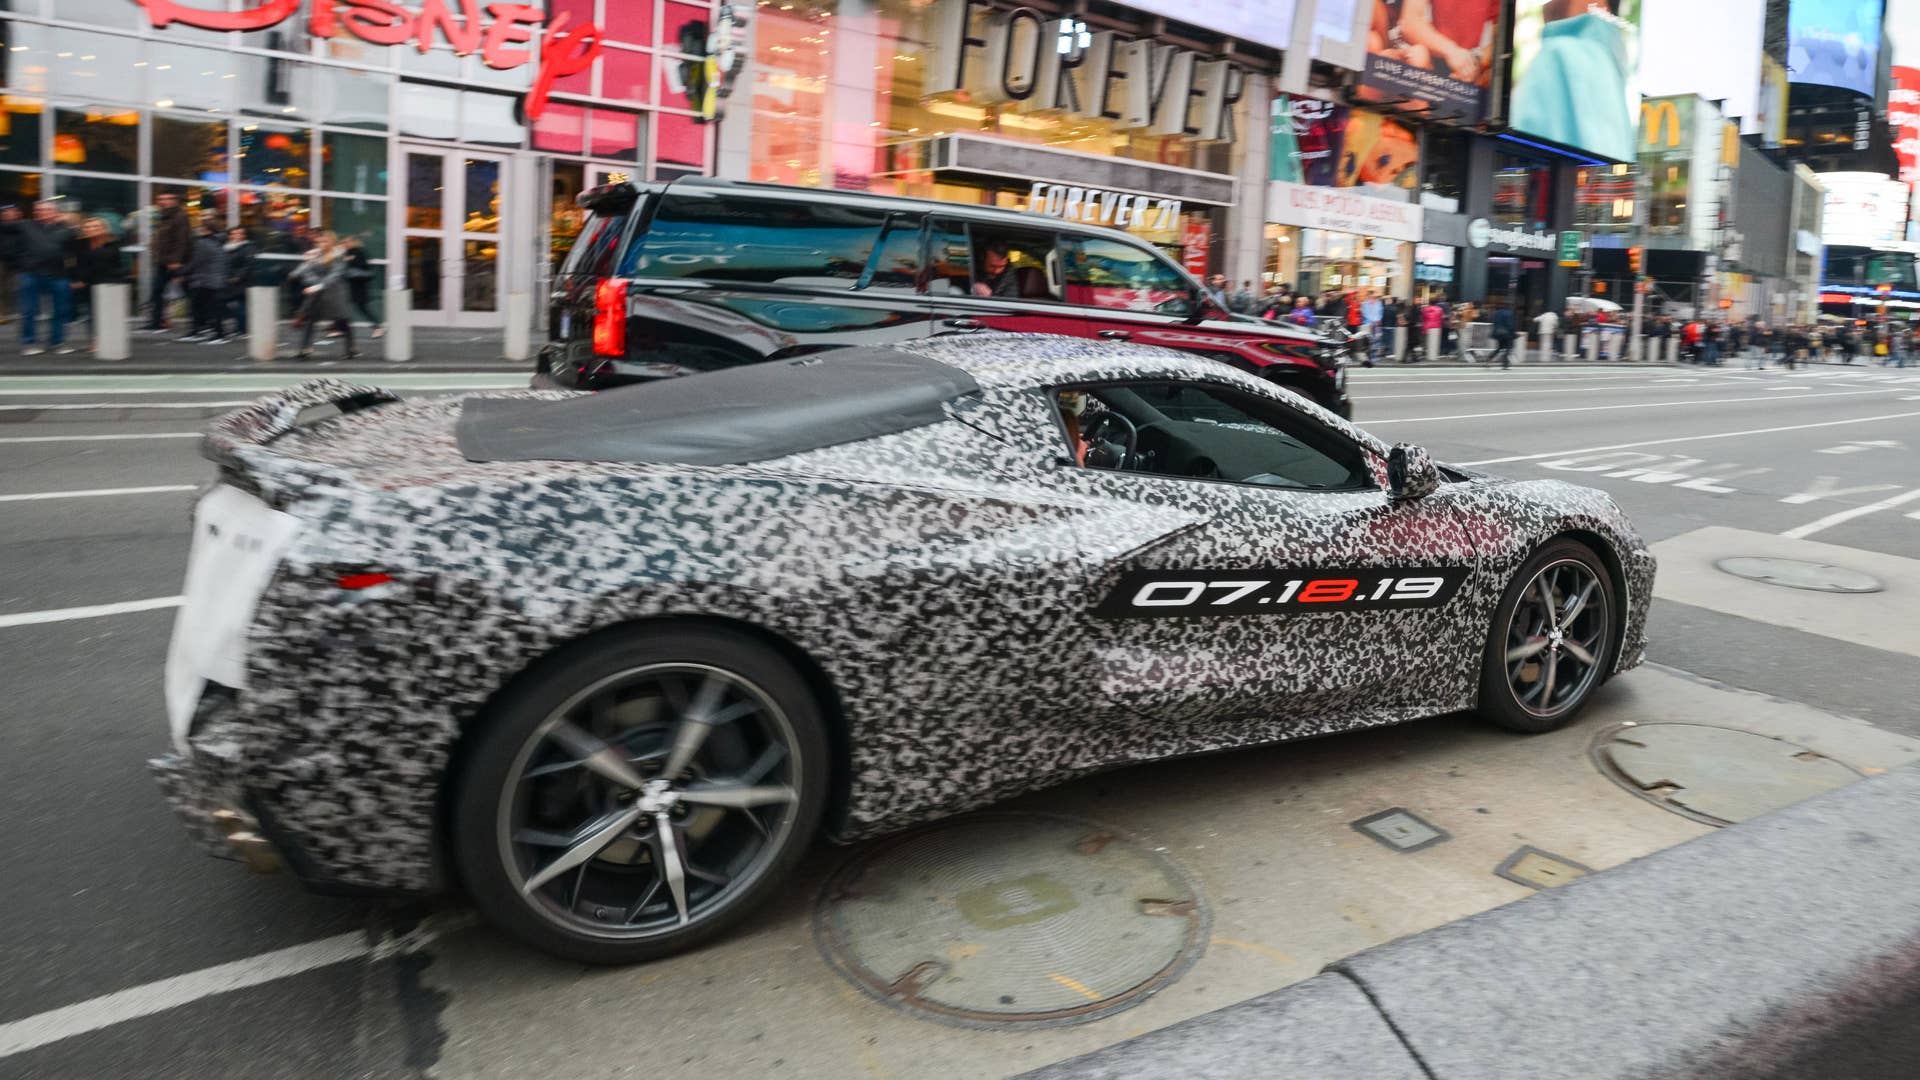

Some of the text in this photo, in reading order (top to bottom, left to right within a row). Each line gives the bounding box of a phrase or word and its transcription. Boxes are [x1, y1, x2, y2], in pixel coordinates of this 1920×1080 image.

[924, 0, 1244, 143] FOREVER
[1028, 182, 1182, 231] FOREVER 21
[1131, 577, 1444, 607] 07.18.19
